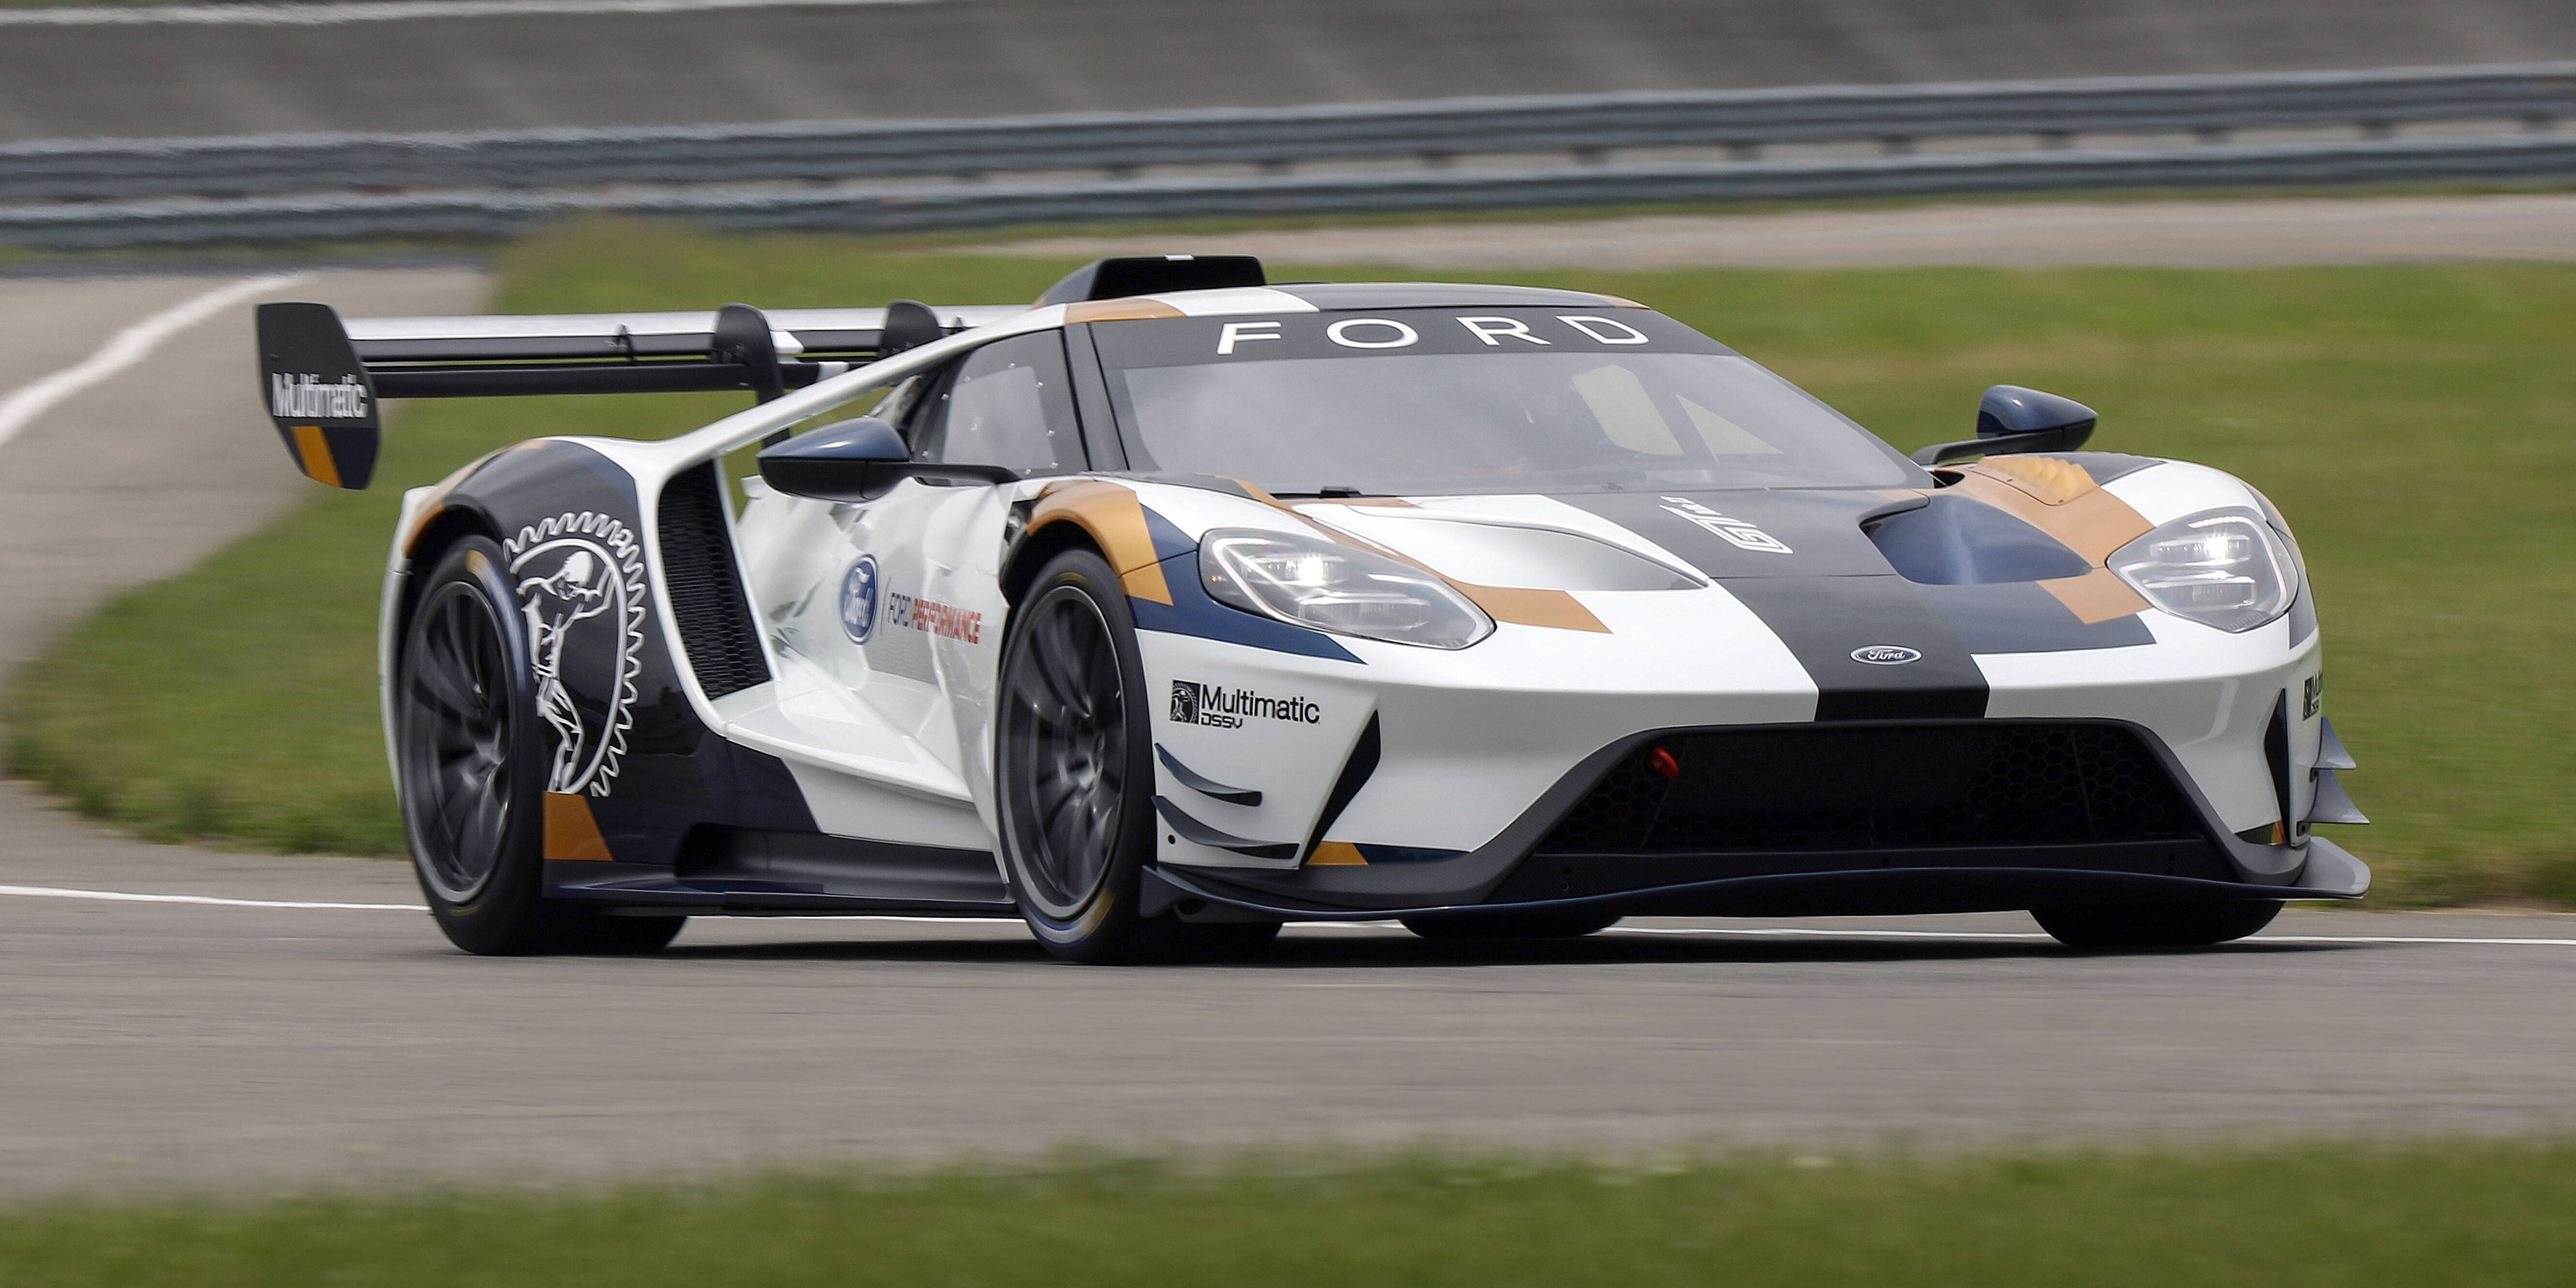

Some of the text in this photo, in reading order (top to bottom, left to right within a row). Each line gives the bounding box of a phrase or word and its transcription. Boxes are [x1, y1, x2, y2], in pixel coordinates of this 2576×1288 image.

[1217, 316, 1649, 354] FORD
[272, 373, 368, 418] Multimatic
[912, 598, 982, 644] PERFORMANCE
[1868, 649, 1905, 660] Ford
[1201, 684, 1320, 724] Multimatic
[1201, 713, 1242, 729] DSSV
